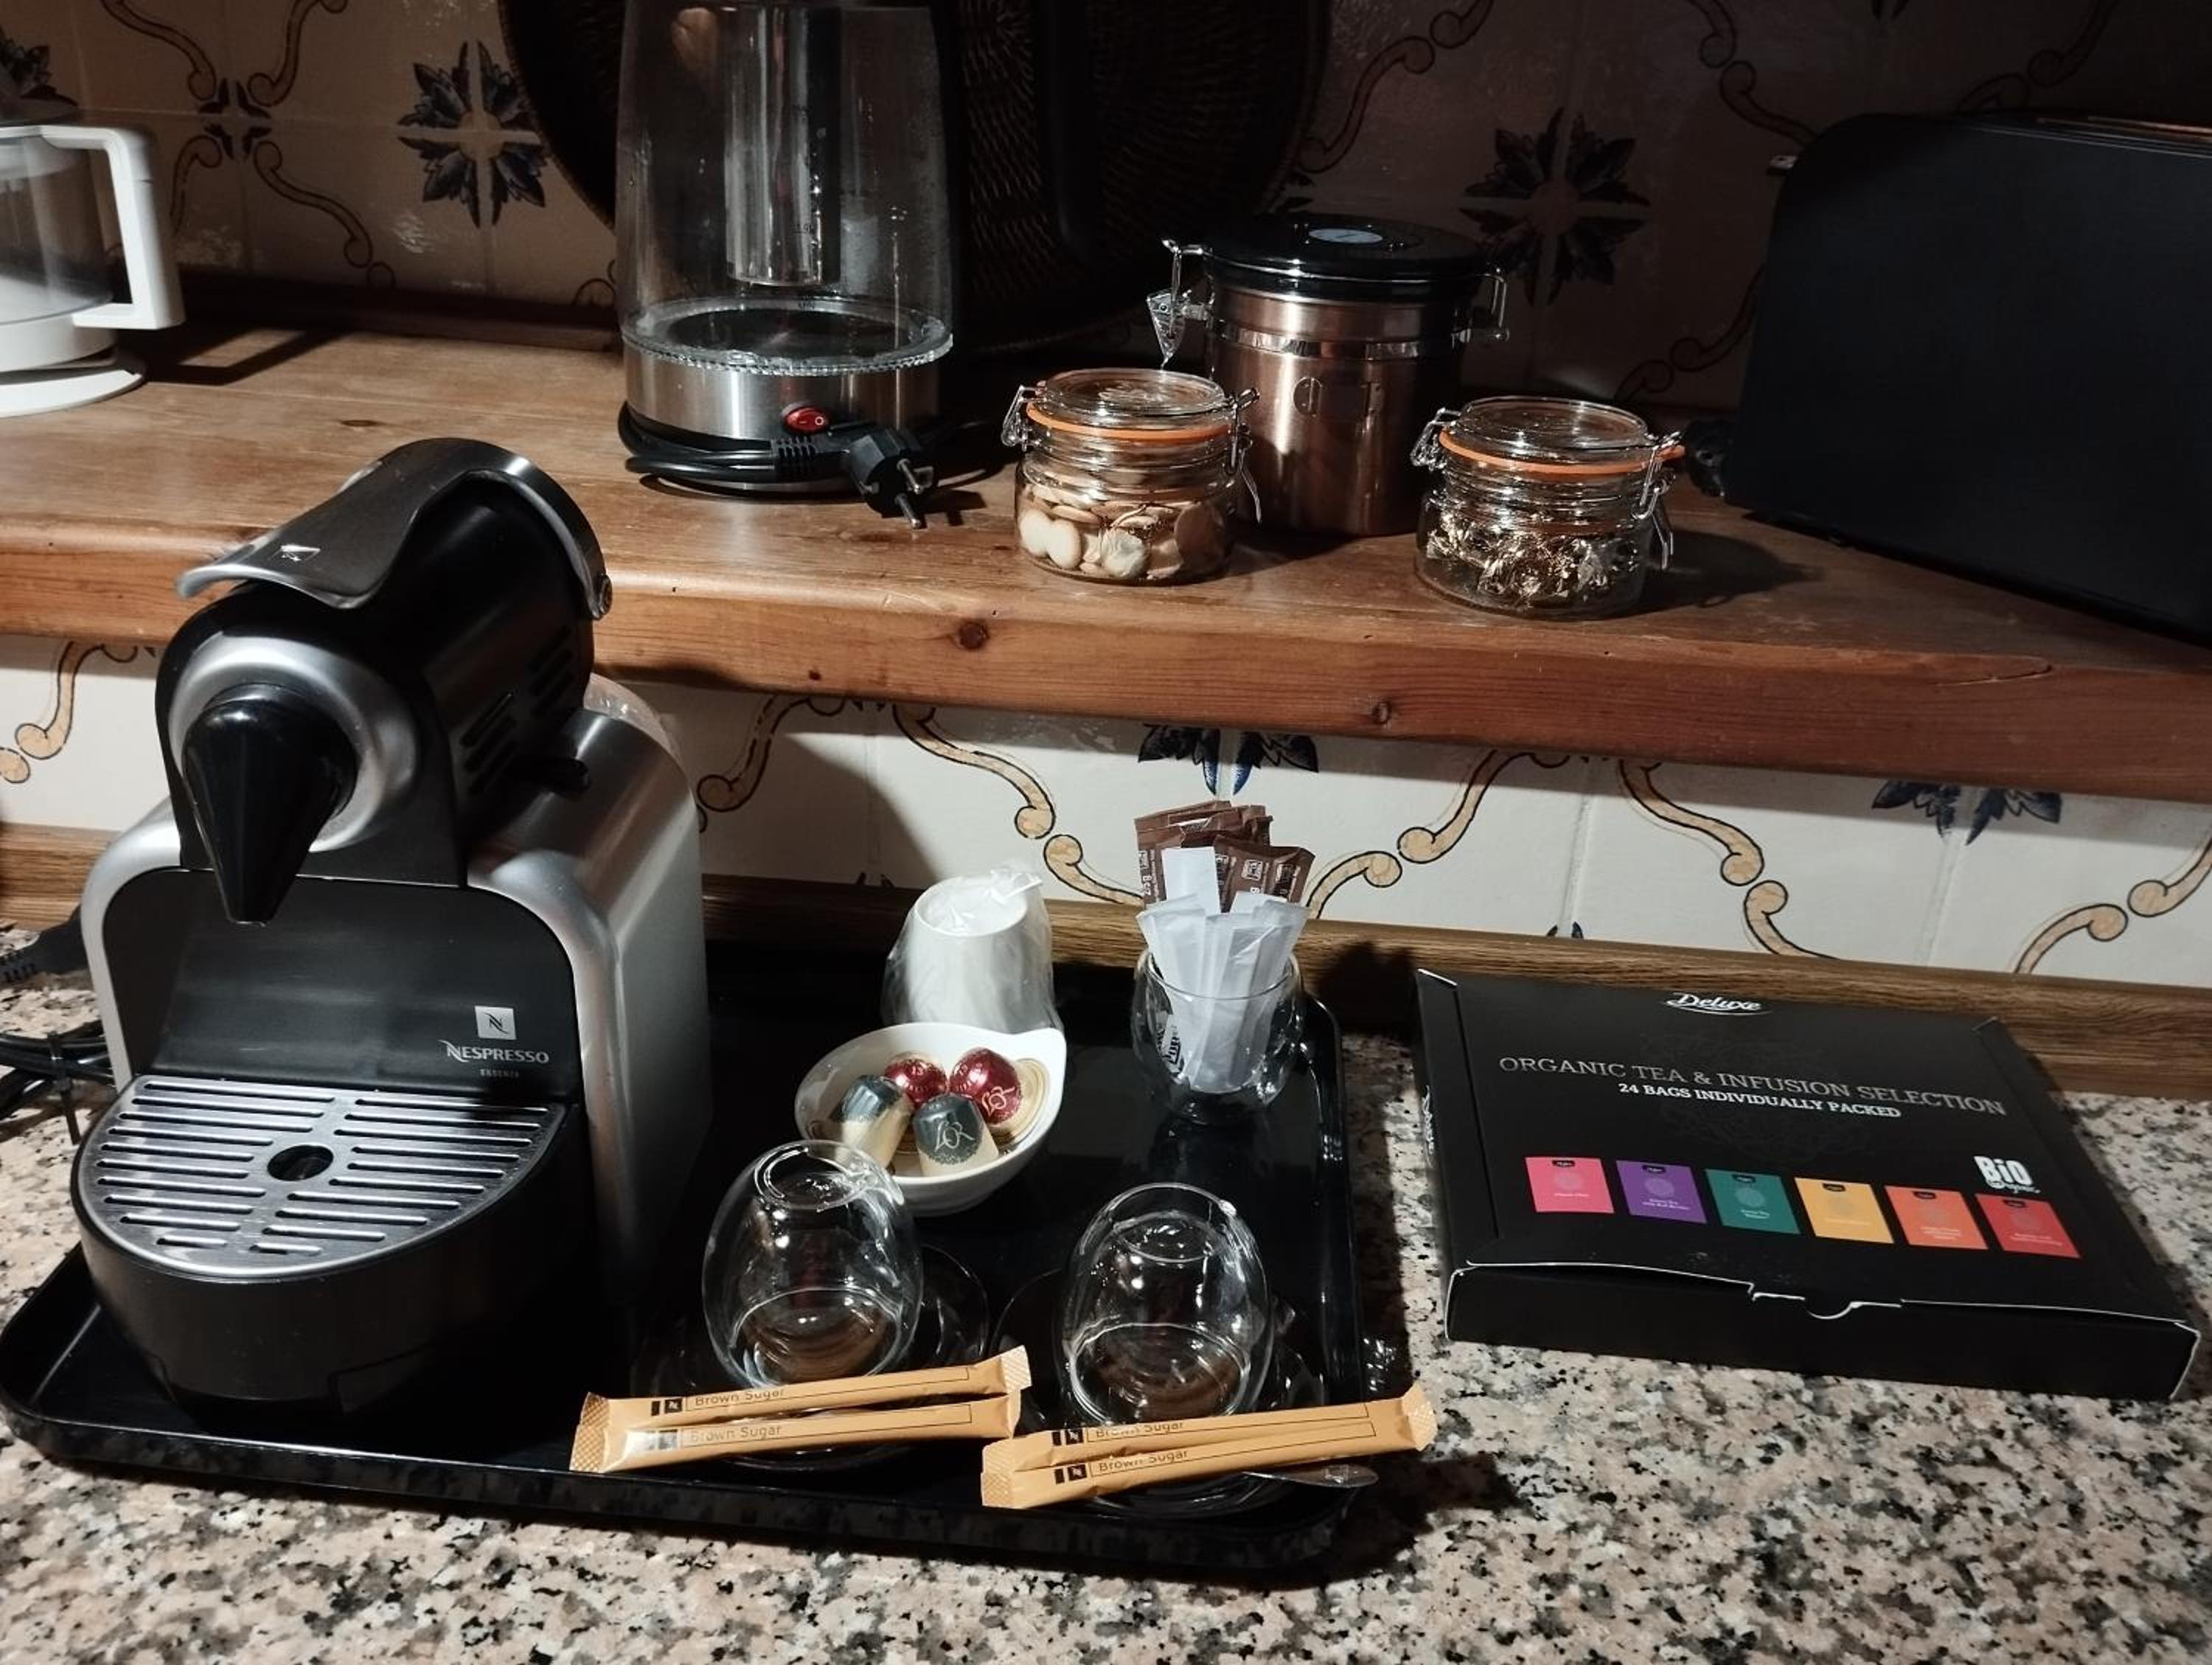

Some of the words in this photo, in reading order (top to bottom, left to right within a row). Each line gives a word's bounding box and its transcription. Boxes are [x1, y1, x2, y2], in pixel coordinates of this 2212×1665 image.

[1666, 992, 1762, 1012] Deluxe
[438, 1039, 549, 1063] NESPRESSO
[1499, 1057, 1627, 1077] ORGANIC
[1632, 1065, 1688, 1083] TEA
[1694, 1071, 1713, 1085] &
[1717, 1072, 1849, 1097] INFUSION
[1857, 1085, 2007, 1116] SELECTION
[1618, 1083, 1639, 1094] 24
[1643, 1085, 1691, 1098] BAGS
[1694, 1089, 1823, 1110] INDIVIDUALLY
[1826, 1101, 1902, 1118] PACKED
[695, 1393, 740, 1406] Brown
[745, 1388, 786, 1402] Sugar
[740, 1425, 782, 1439] Sugar
